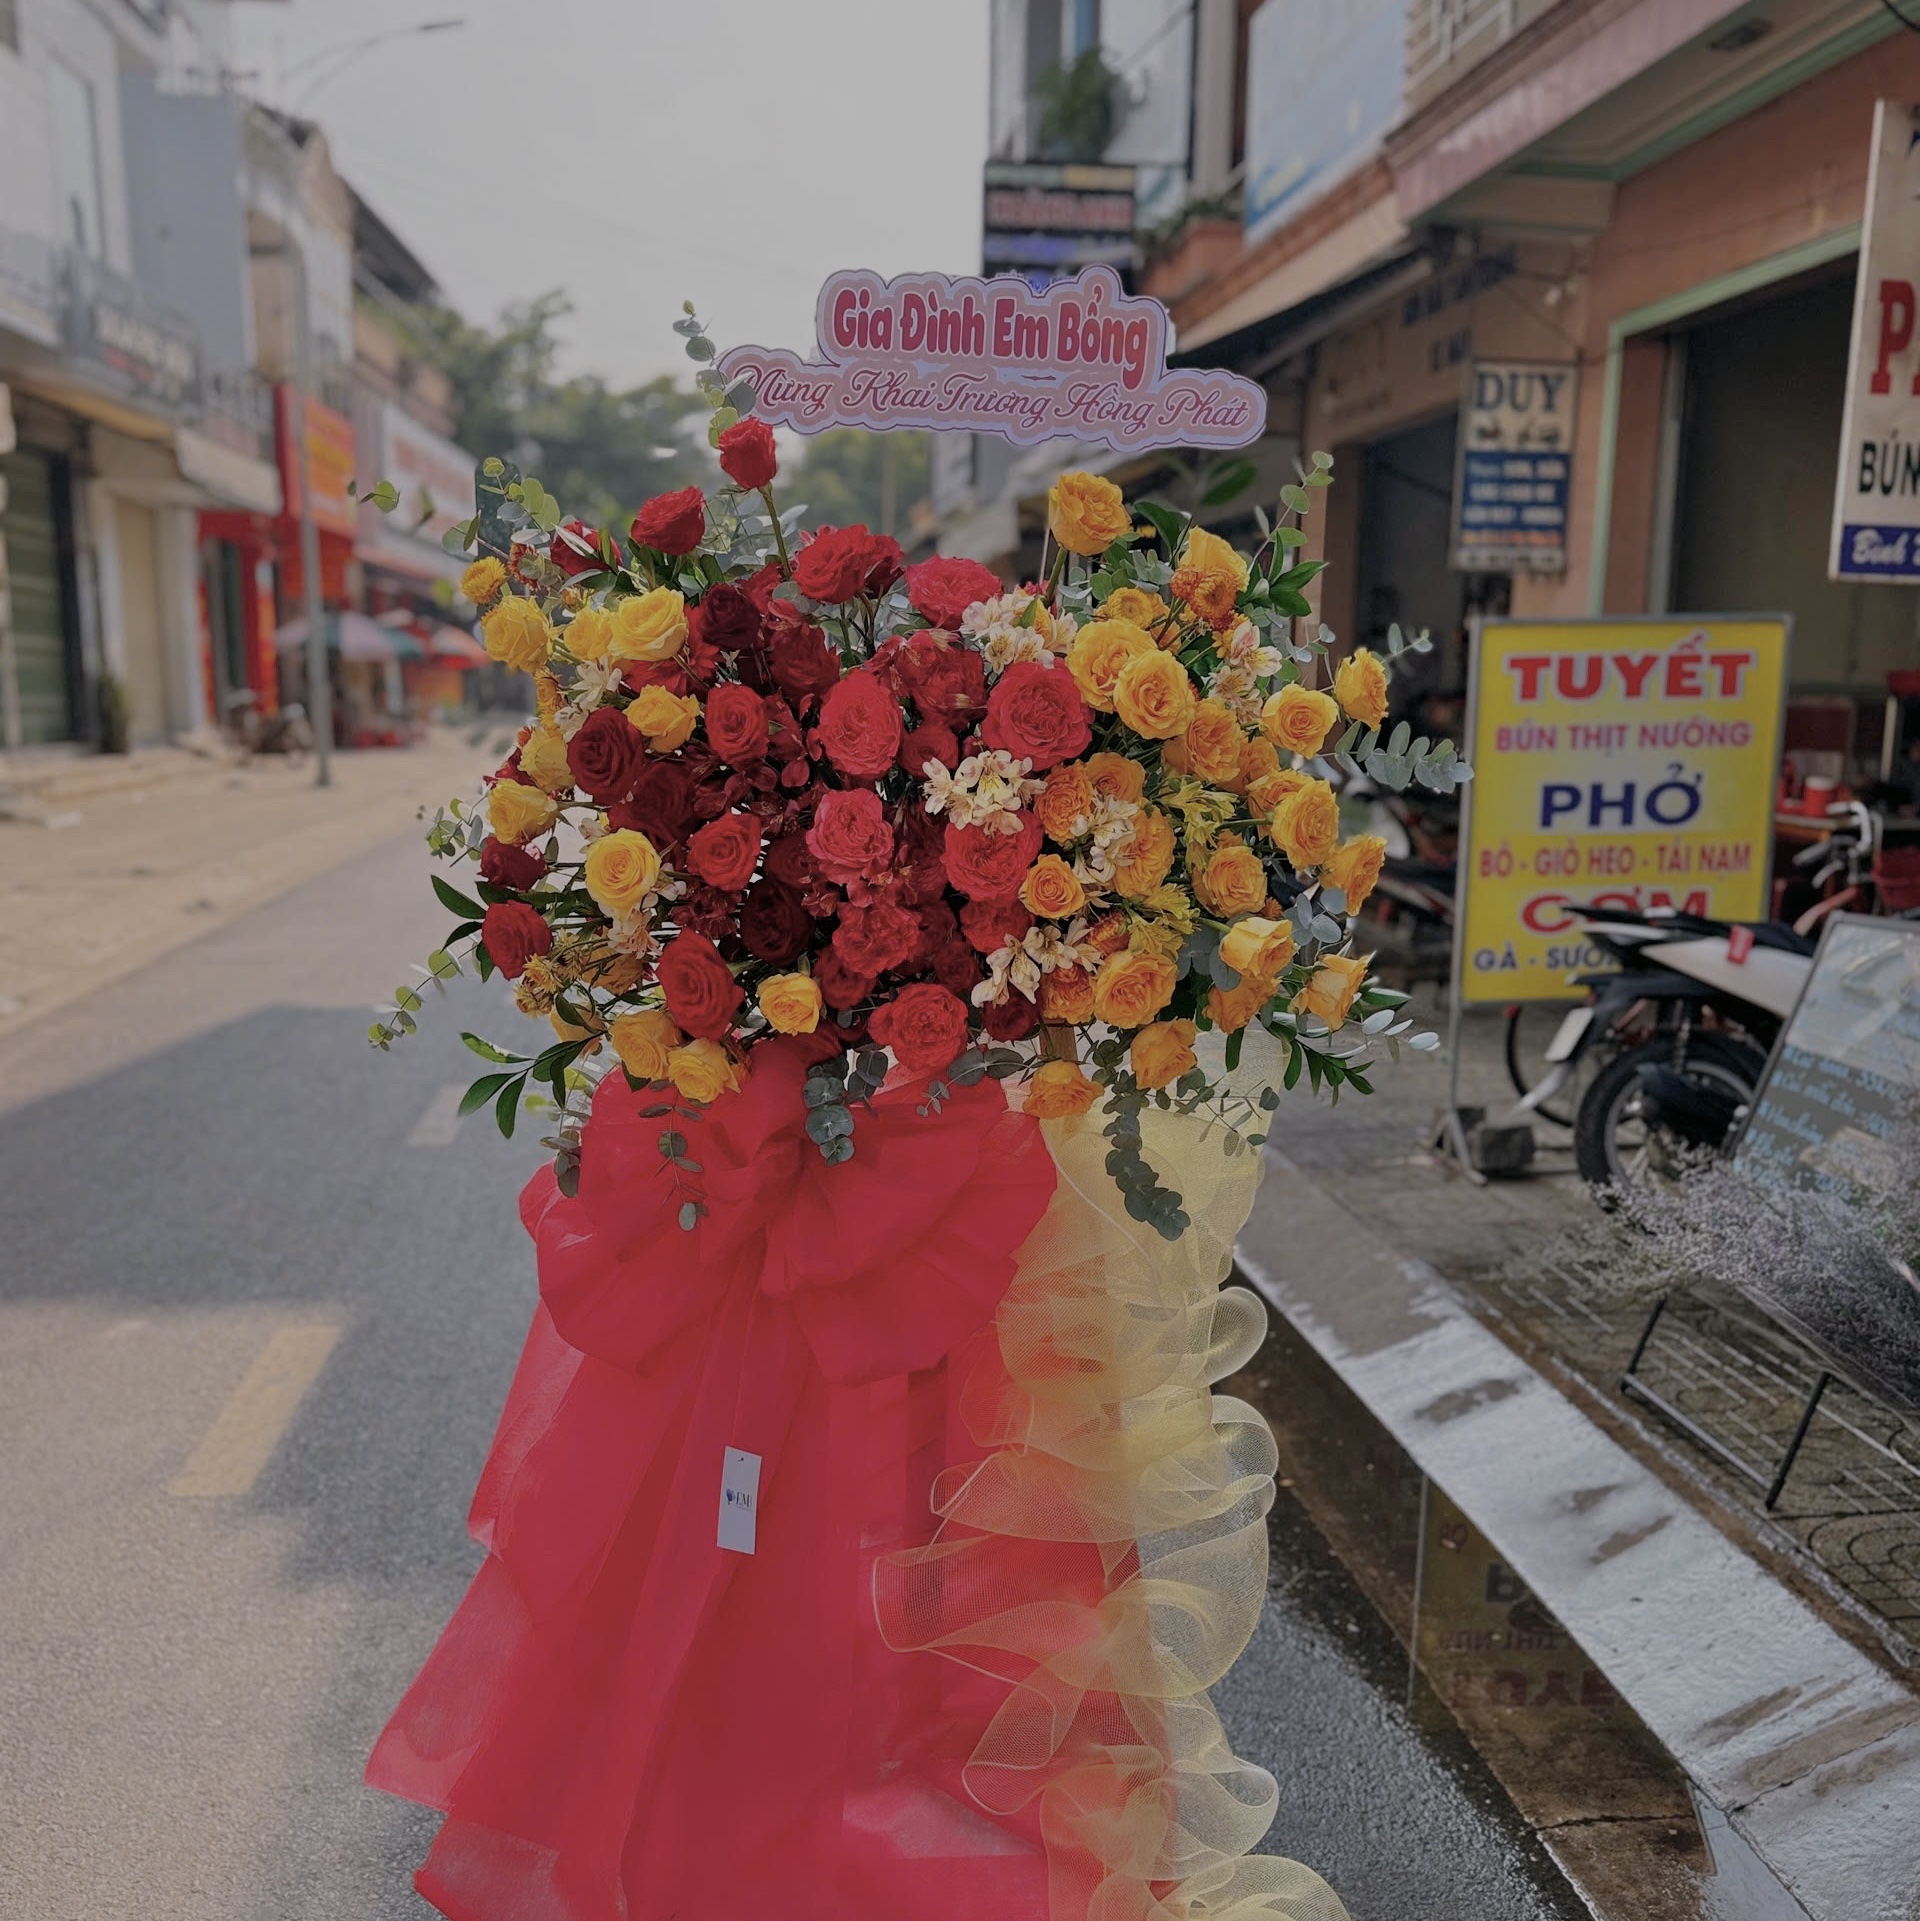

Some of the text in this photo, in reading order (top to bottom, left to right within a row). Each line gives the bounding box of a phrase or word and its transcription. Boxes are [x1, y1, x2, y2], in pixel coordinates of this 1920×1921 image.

[834, 285, 1149, 390] Gia Đình Em Bổng
[842, 368, 937, 412] Khai
[936, 373, 1053, 428] Trương
[1054, 382, 1154, 434] Hồng
[1158, 388, 1249, 426] Phát
[1476, 372, 1565, 413] DUY
[1509, 634, 1751, 700] TUYẾT
[1495, 714, 1751, 758] BÚN THỊT NƯỚNG
[1539, 762, 1703, 828] PHỞ
[1587, 845, 1636, 876] HEO
